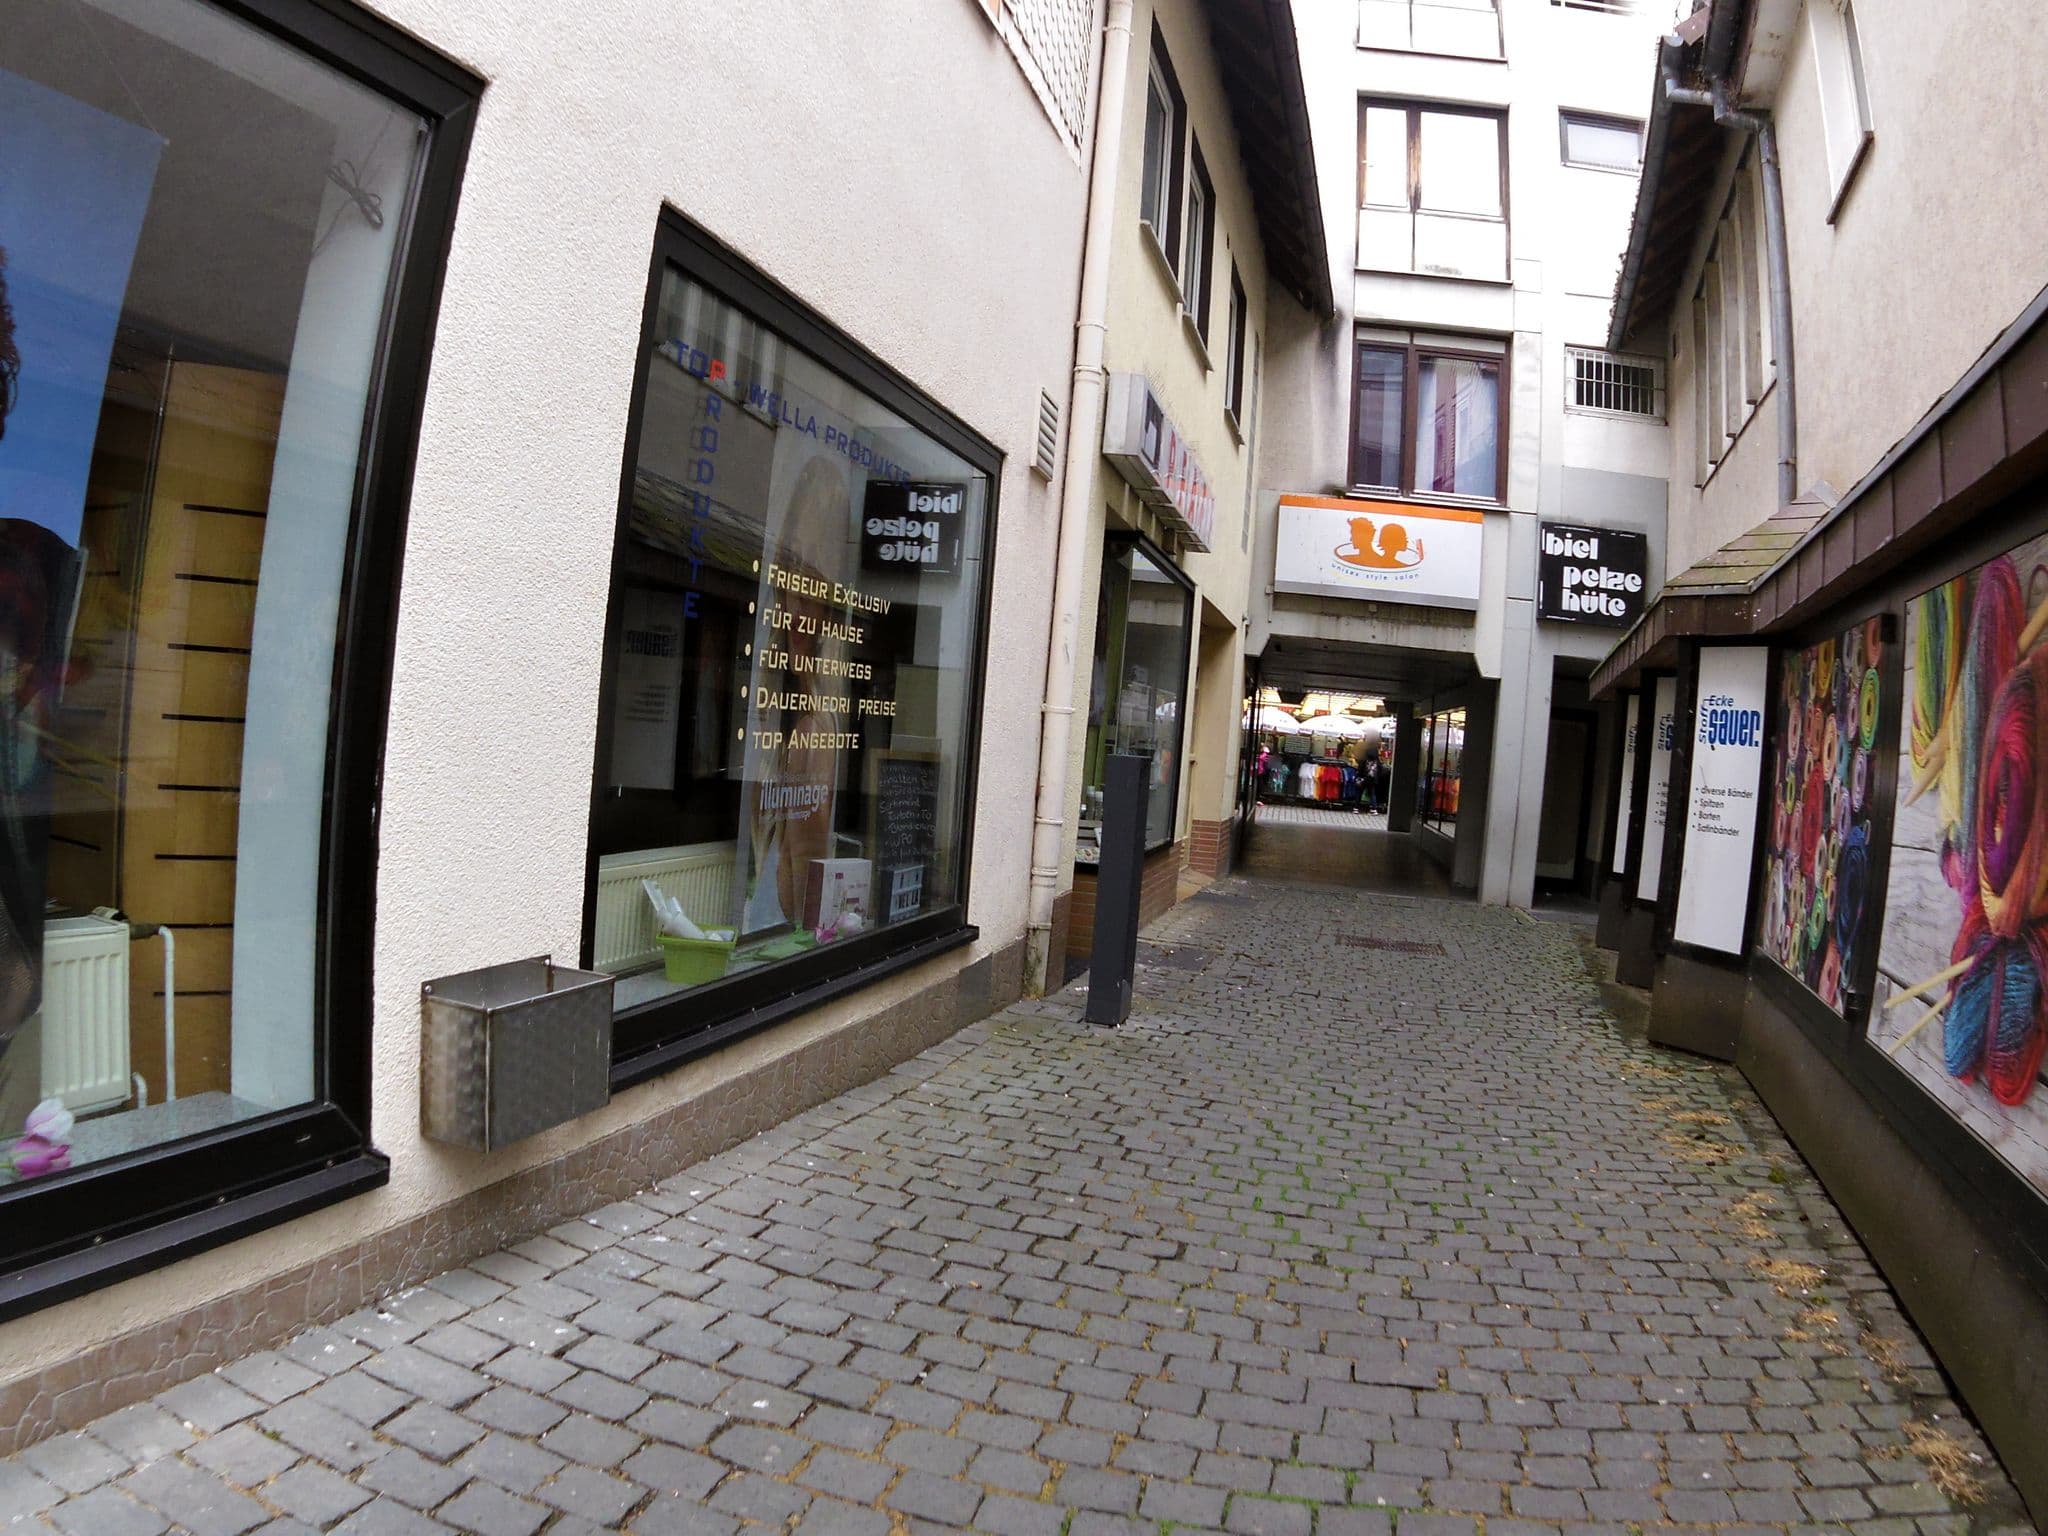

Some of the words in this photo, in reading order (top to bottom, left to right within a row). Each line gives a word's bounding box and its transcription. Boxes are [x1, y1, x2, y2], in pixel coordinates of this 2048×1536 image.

[674, 337, 727, 381] TOP
[749, 383, 818, 439] WELLA
[825, 425, 912, 491] PRODUKTE
[1545, 532, 1599, 560] biel
[767, 563, 828, 600] FRISEUR
[833, 583, 891, 615] EXCLUSIV
[1562, 566, 1642, 593] pelze
[1561, 588, 1626, 617] hüte
[762, 602, 792, 631] FÜR
[798, 616, 817, 635] ZU
[821, 620, 864, 644] HAUSE
[759, 643, 789, 670] FÜR
[794, 654, 872, 680] UNTERWEGS
[858, 699, 897, 721] PREISE
[1708, 694, 1735, 707] Ecke
[753, 731, 783, 750] TOP
[788, 728, 860, 750] ANGEBOTE
